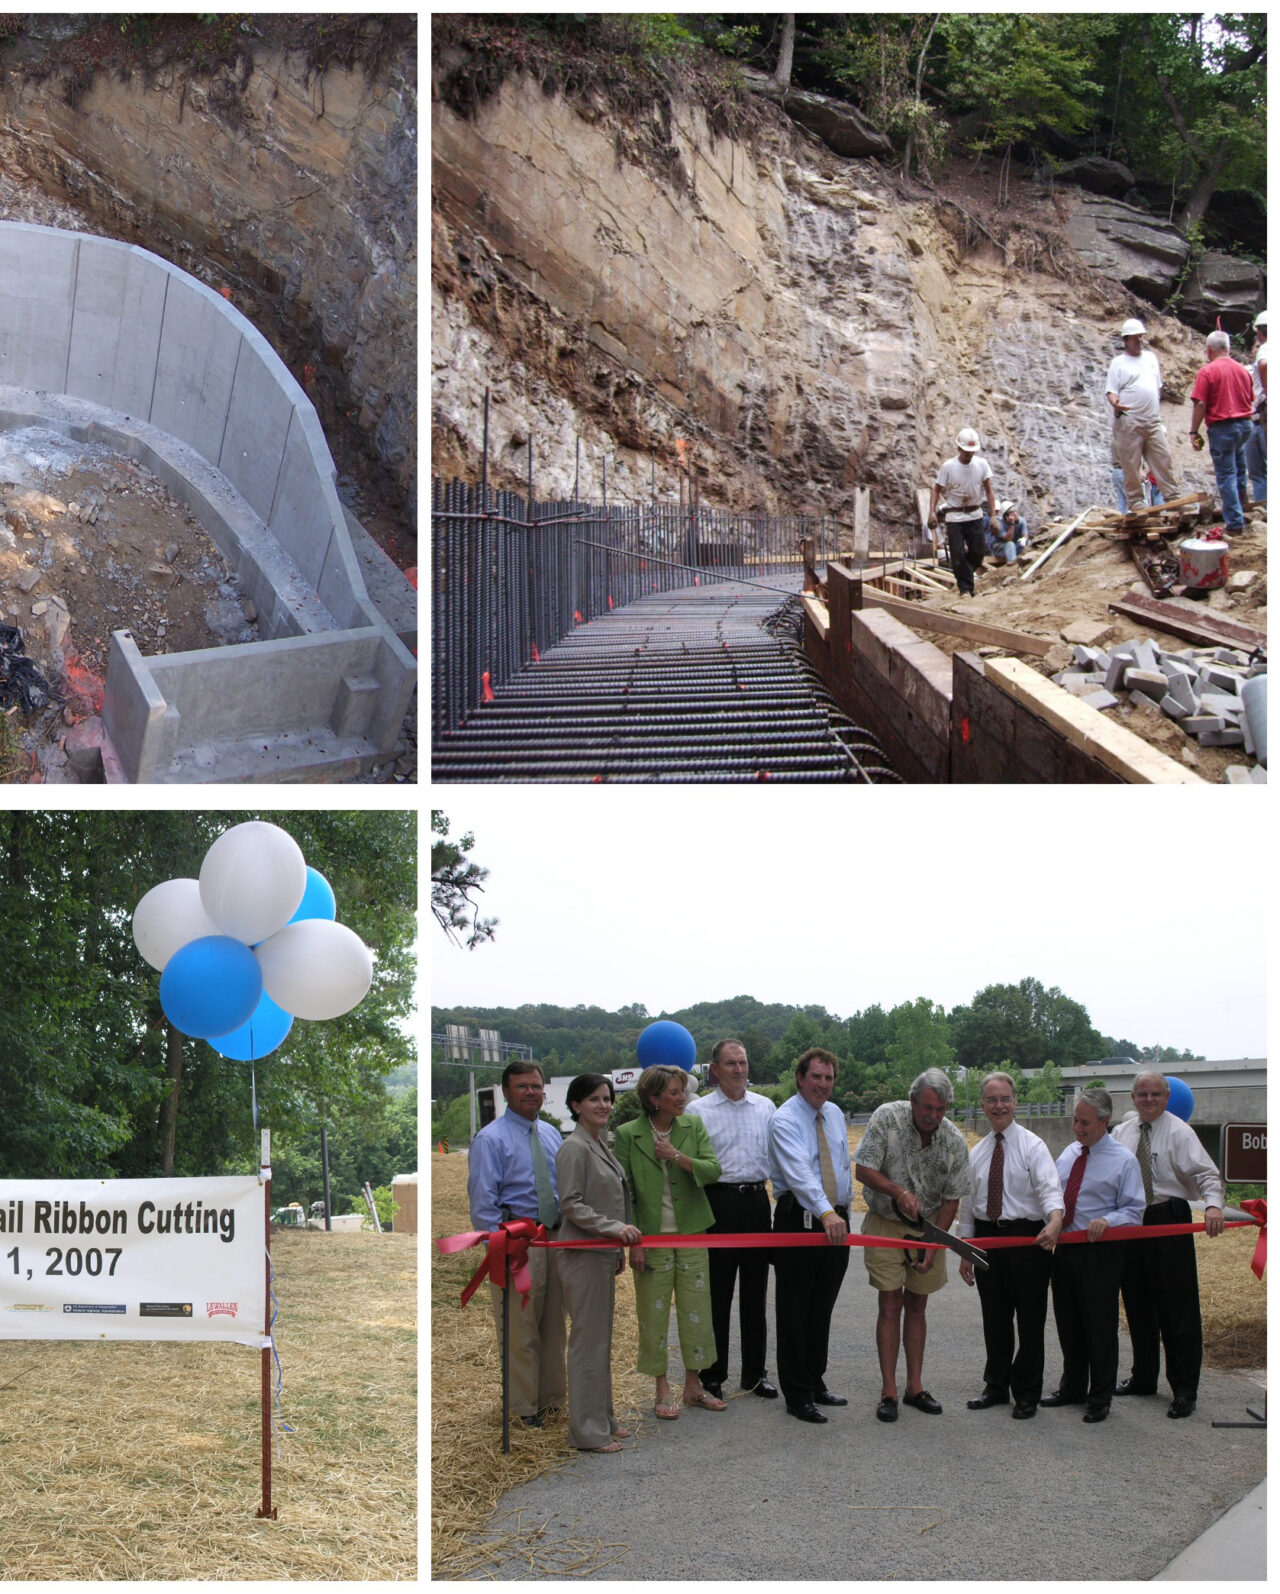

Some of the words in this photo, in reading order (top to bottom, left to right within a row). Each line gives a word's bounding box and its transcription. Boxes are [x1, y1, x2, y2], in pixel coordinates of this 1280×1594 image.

[1242, 1132, 1267, 1150] Bob
[34, 1200, 128, 1235] Ribbon
[137, 1200, 235, 1243] Cutting
[7, 1246, 33, 1281] 1,
[45, 1247, 123, 1277] 2007
[206, 1302, 239, 1313] LEWALLEN
